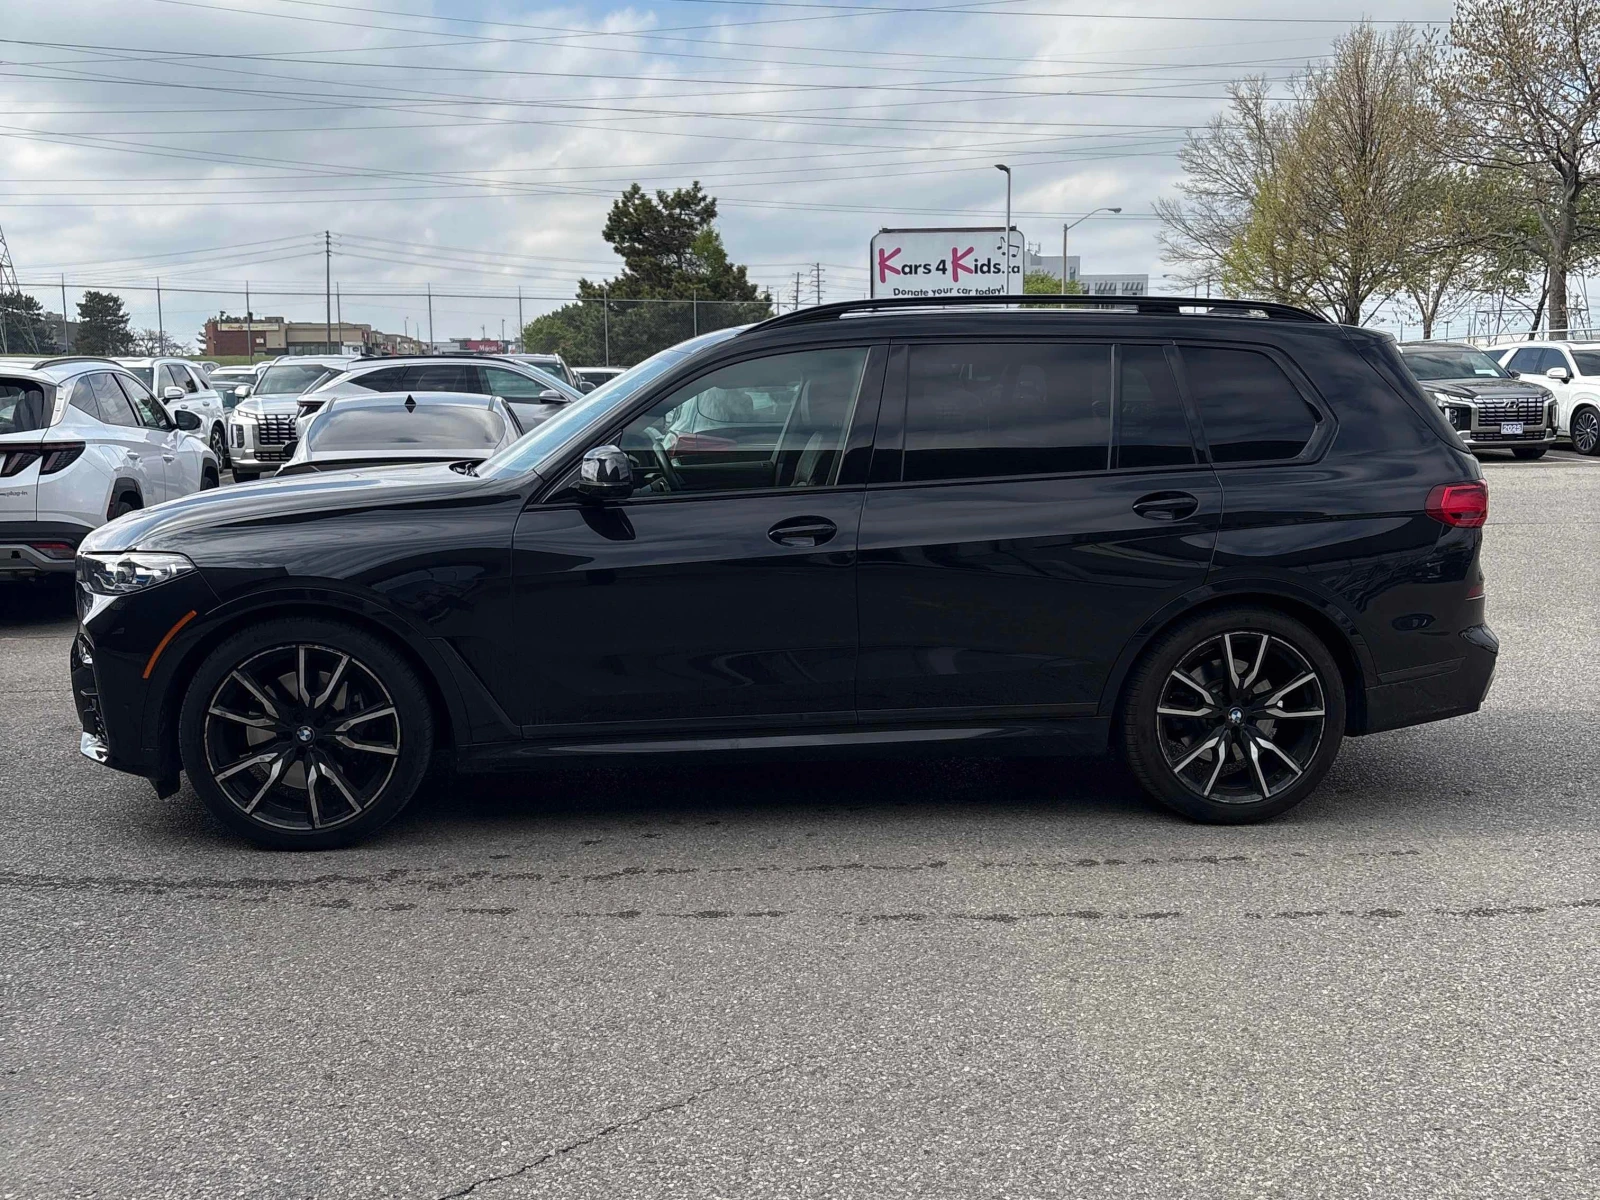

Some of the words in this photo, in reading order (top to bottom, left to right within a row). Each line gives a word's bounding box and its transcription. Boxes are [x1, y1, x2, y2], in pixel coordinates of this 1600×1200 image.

[878, 247, 932, 283] Kars
[935, 259, 947, 275] 4
[893, 287, 929, 296] Donate
[931, 287, 954, 296] your
[957, 287, 973, 295] car
[975, 285, 1005, 296] today!
